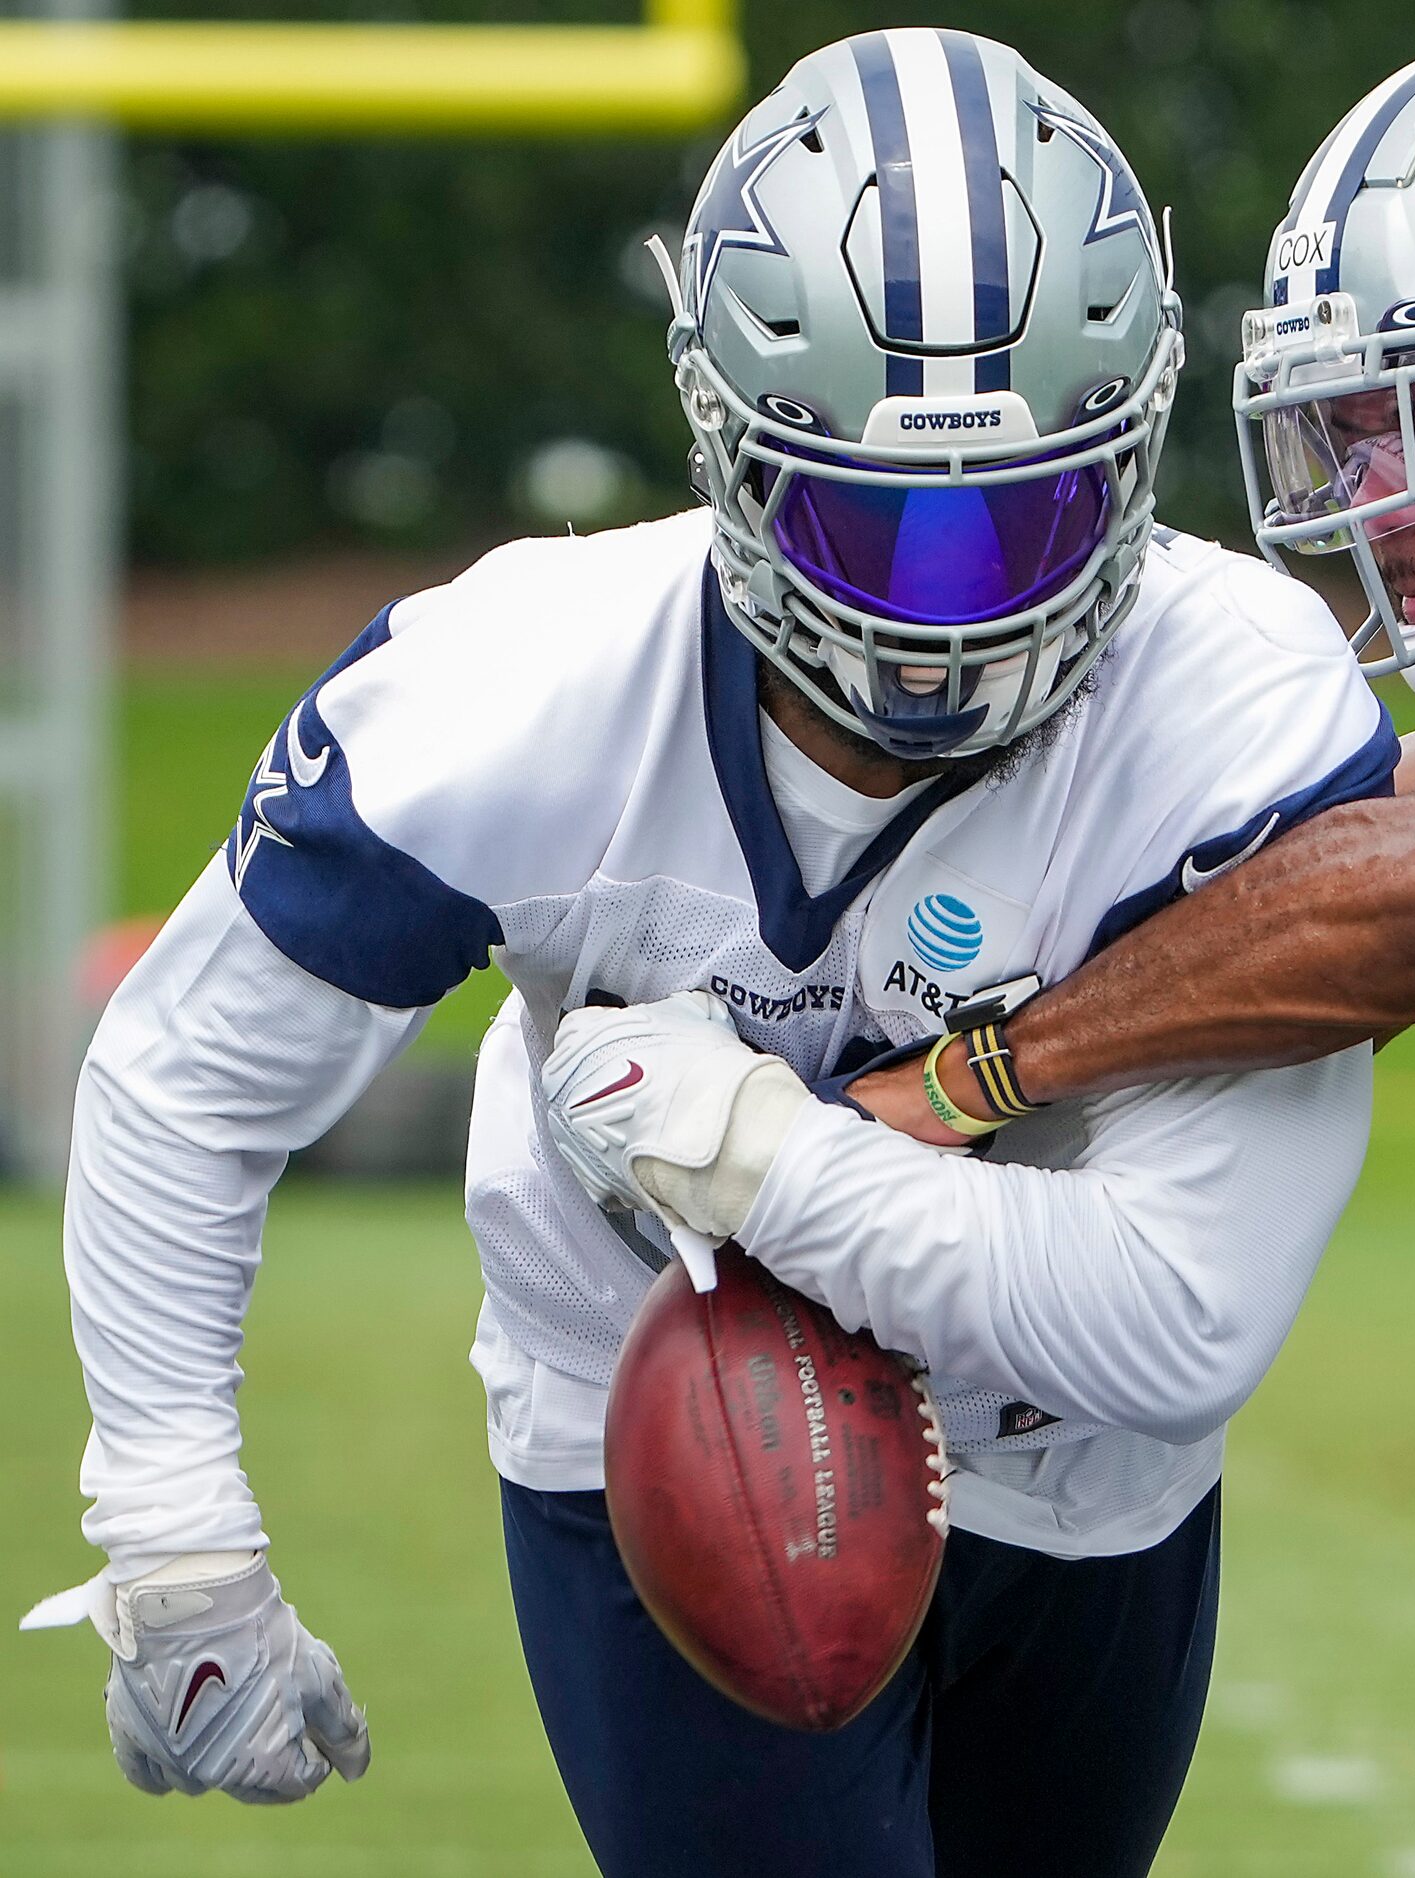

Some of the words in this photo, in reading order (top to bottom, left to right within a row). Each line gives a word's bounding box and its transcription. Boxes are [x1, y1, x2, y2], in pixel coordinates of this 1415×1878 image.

[1279, 230, 1327, 271] COX
[900, 410, 1001, 431] COWBOYS
[883, 960, 970, 1018] AT&T
[794, 1354, 831, 1463] FOOTBALL
[815, 1470, 837, 1558] LEAGUE
